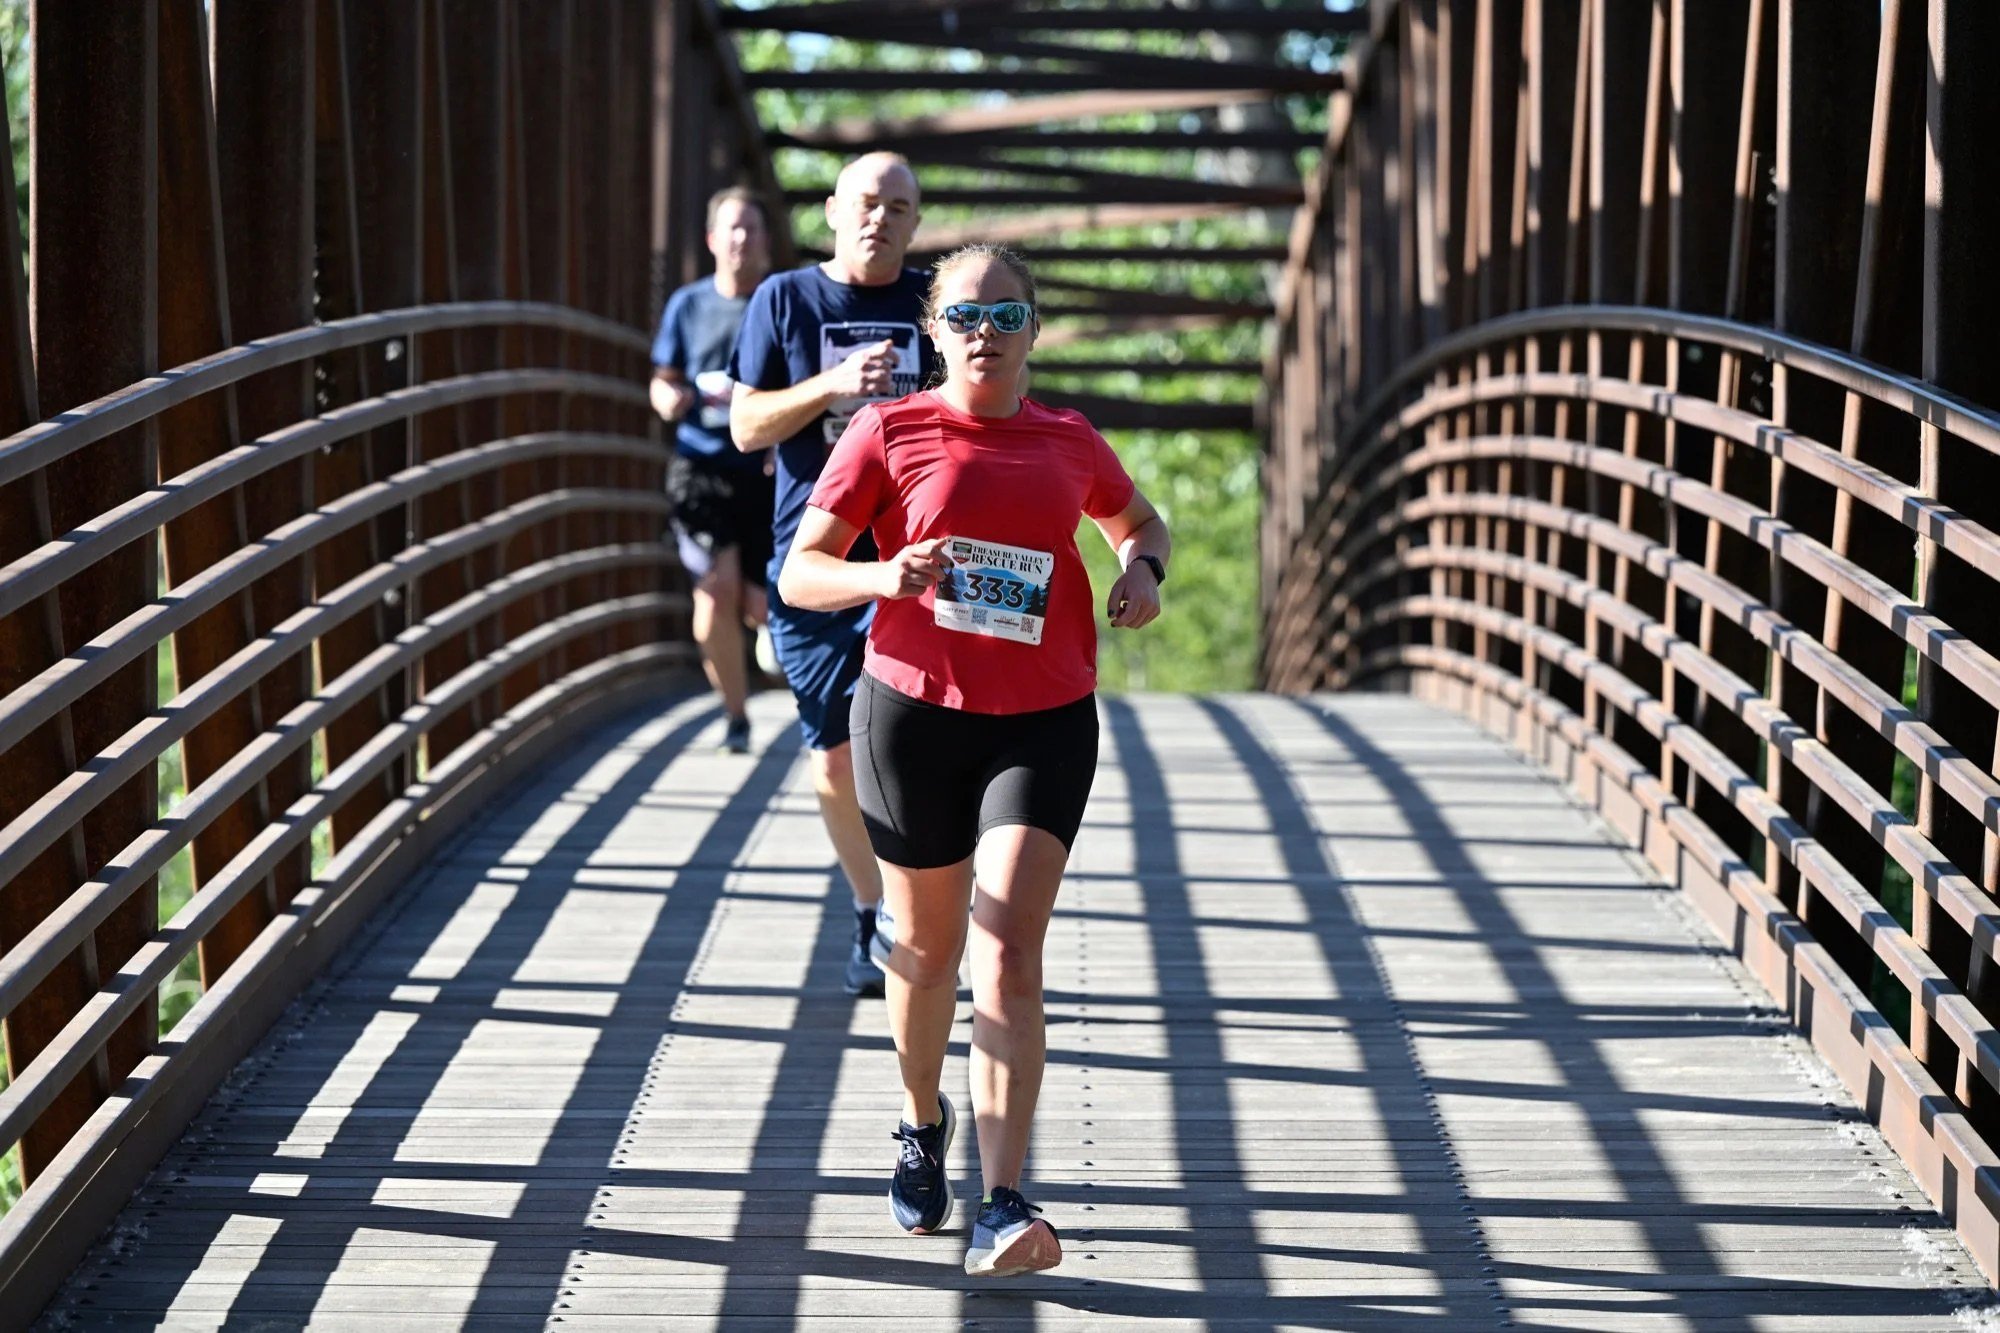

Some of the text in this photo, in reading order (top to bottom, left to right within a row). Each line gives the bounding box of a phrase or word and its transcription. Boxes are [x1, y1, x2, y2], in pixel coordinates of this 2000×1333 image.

[971, 553, 1017, 571] RESCUE
[1019, 561, 1043, 575] RUN
[972, 545, 1014, 559] TREASURE
[1015, 552, 1044, 565] VALLEY
[962, 573, 1026, 609] 333
